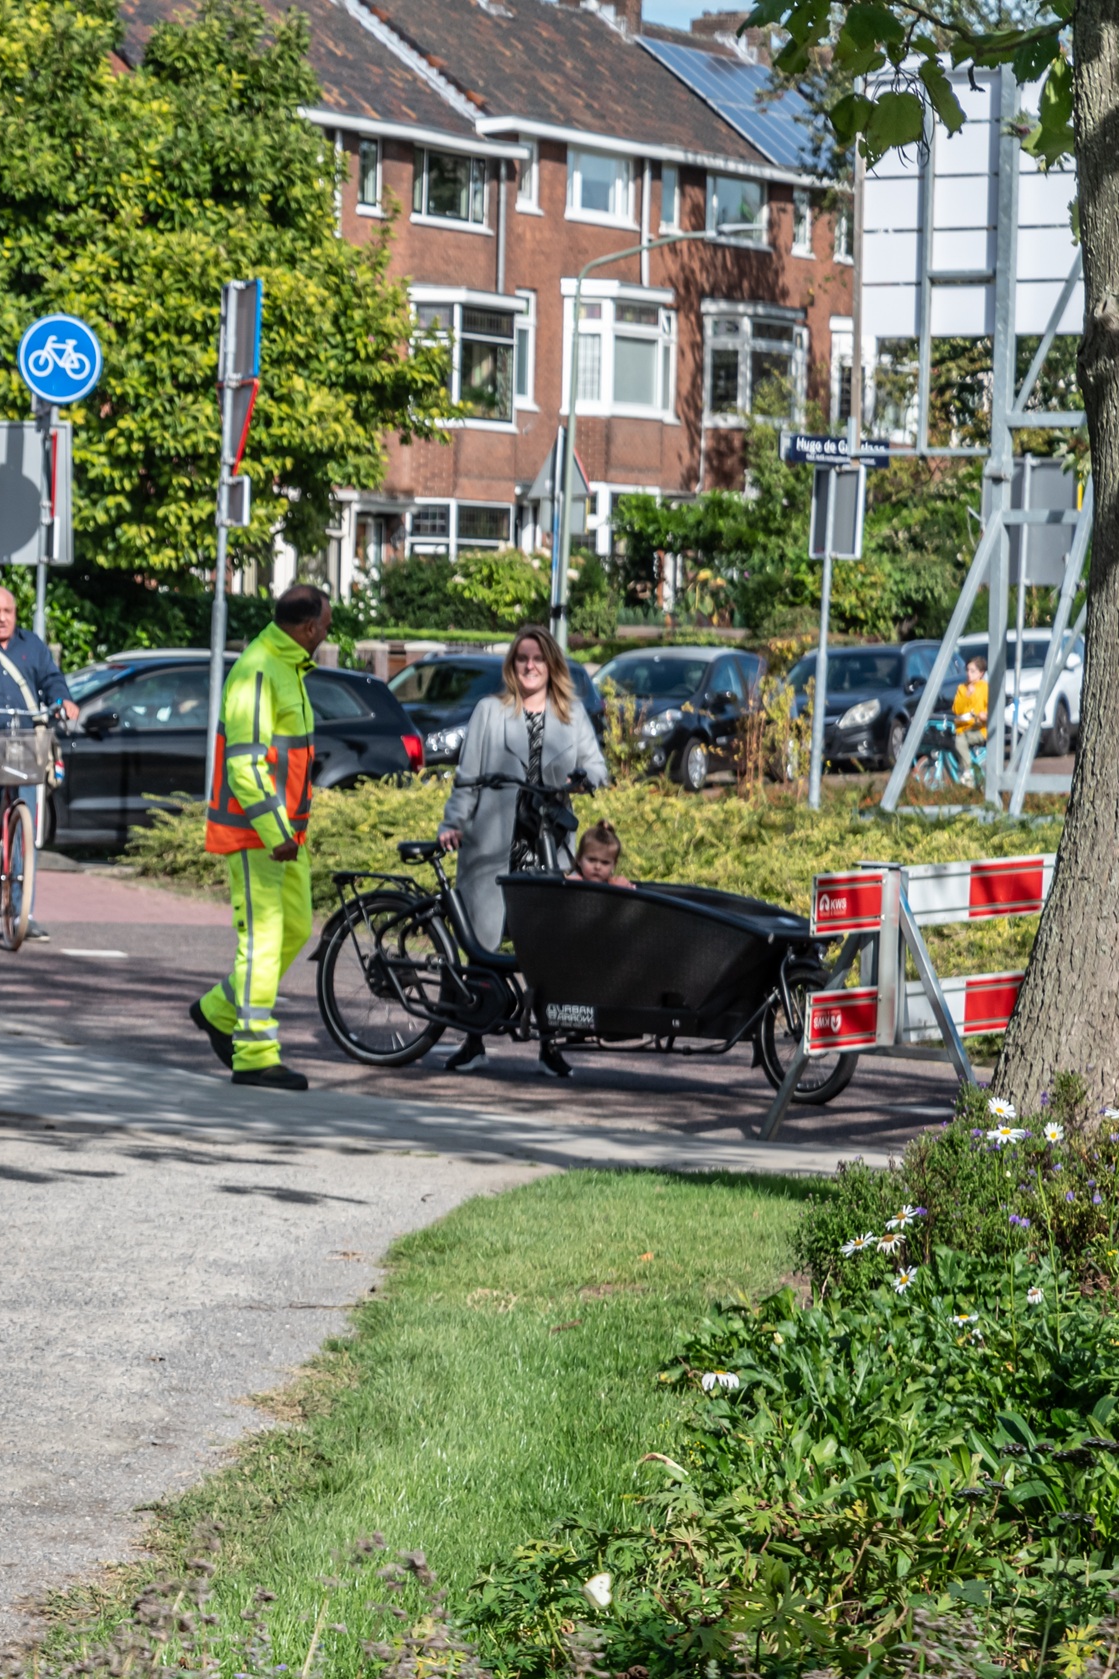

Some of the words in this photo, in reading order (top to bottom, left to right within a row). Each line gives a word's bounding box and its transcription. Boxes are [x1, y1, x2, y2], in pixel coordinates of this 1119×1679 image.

[796, 436, 822, 454] Hugo
[824, 440, 837, 454] de
[830, 897, 847, 910] KWS
[557, 1004, 594, 1015] URBAN
[557, 1013, 594, 1023] ARROW
